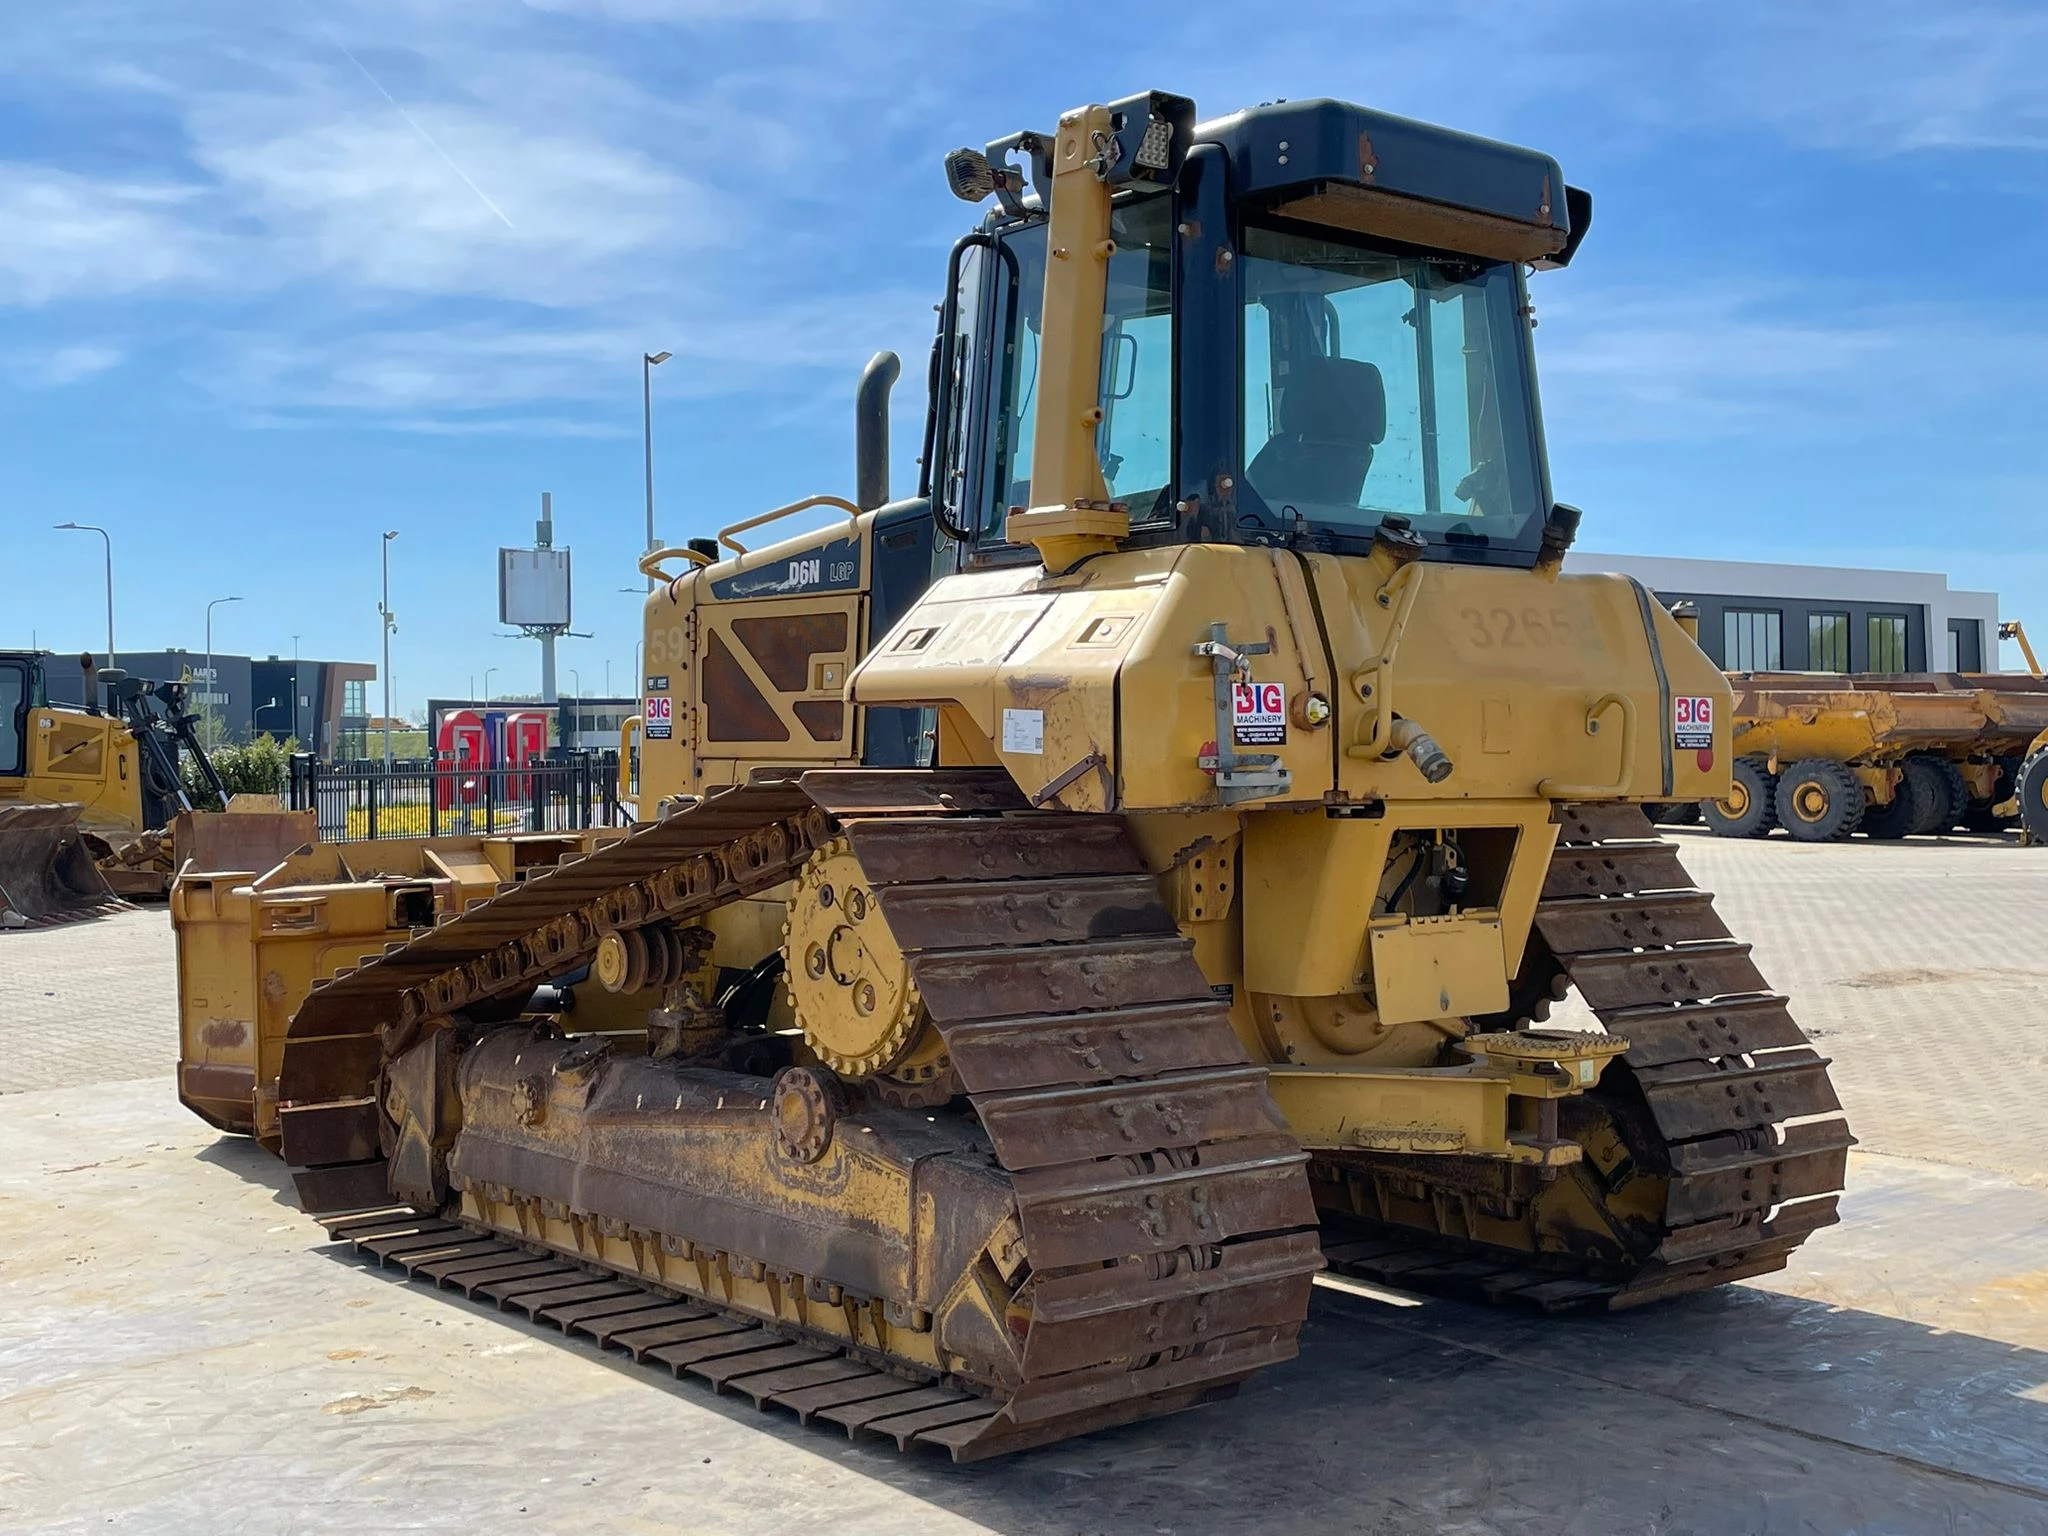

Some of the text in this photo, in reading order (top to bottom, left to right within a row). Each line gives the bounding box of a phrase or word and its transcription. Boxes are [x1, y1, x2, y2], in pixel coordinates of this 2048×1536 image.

[789, 559, 855, 585] D6N LGP
[651, 626, 684, 664] 59
[647, 699, 670, 718] BIG
[1236, 685, 1282, 713] BIG
[1677, 698, 1711, 723] BIG
[1236, 715, 1282, 723] MACHINERY
[1677, 724, 1711, 732] MACHINERY
